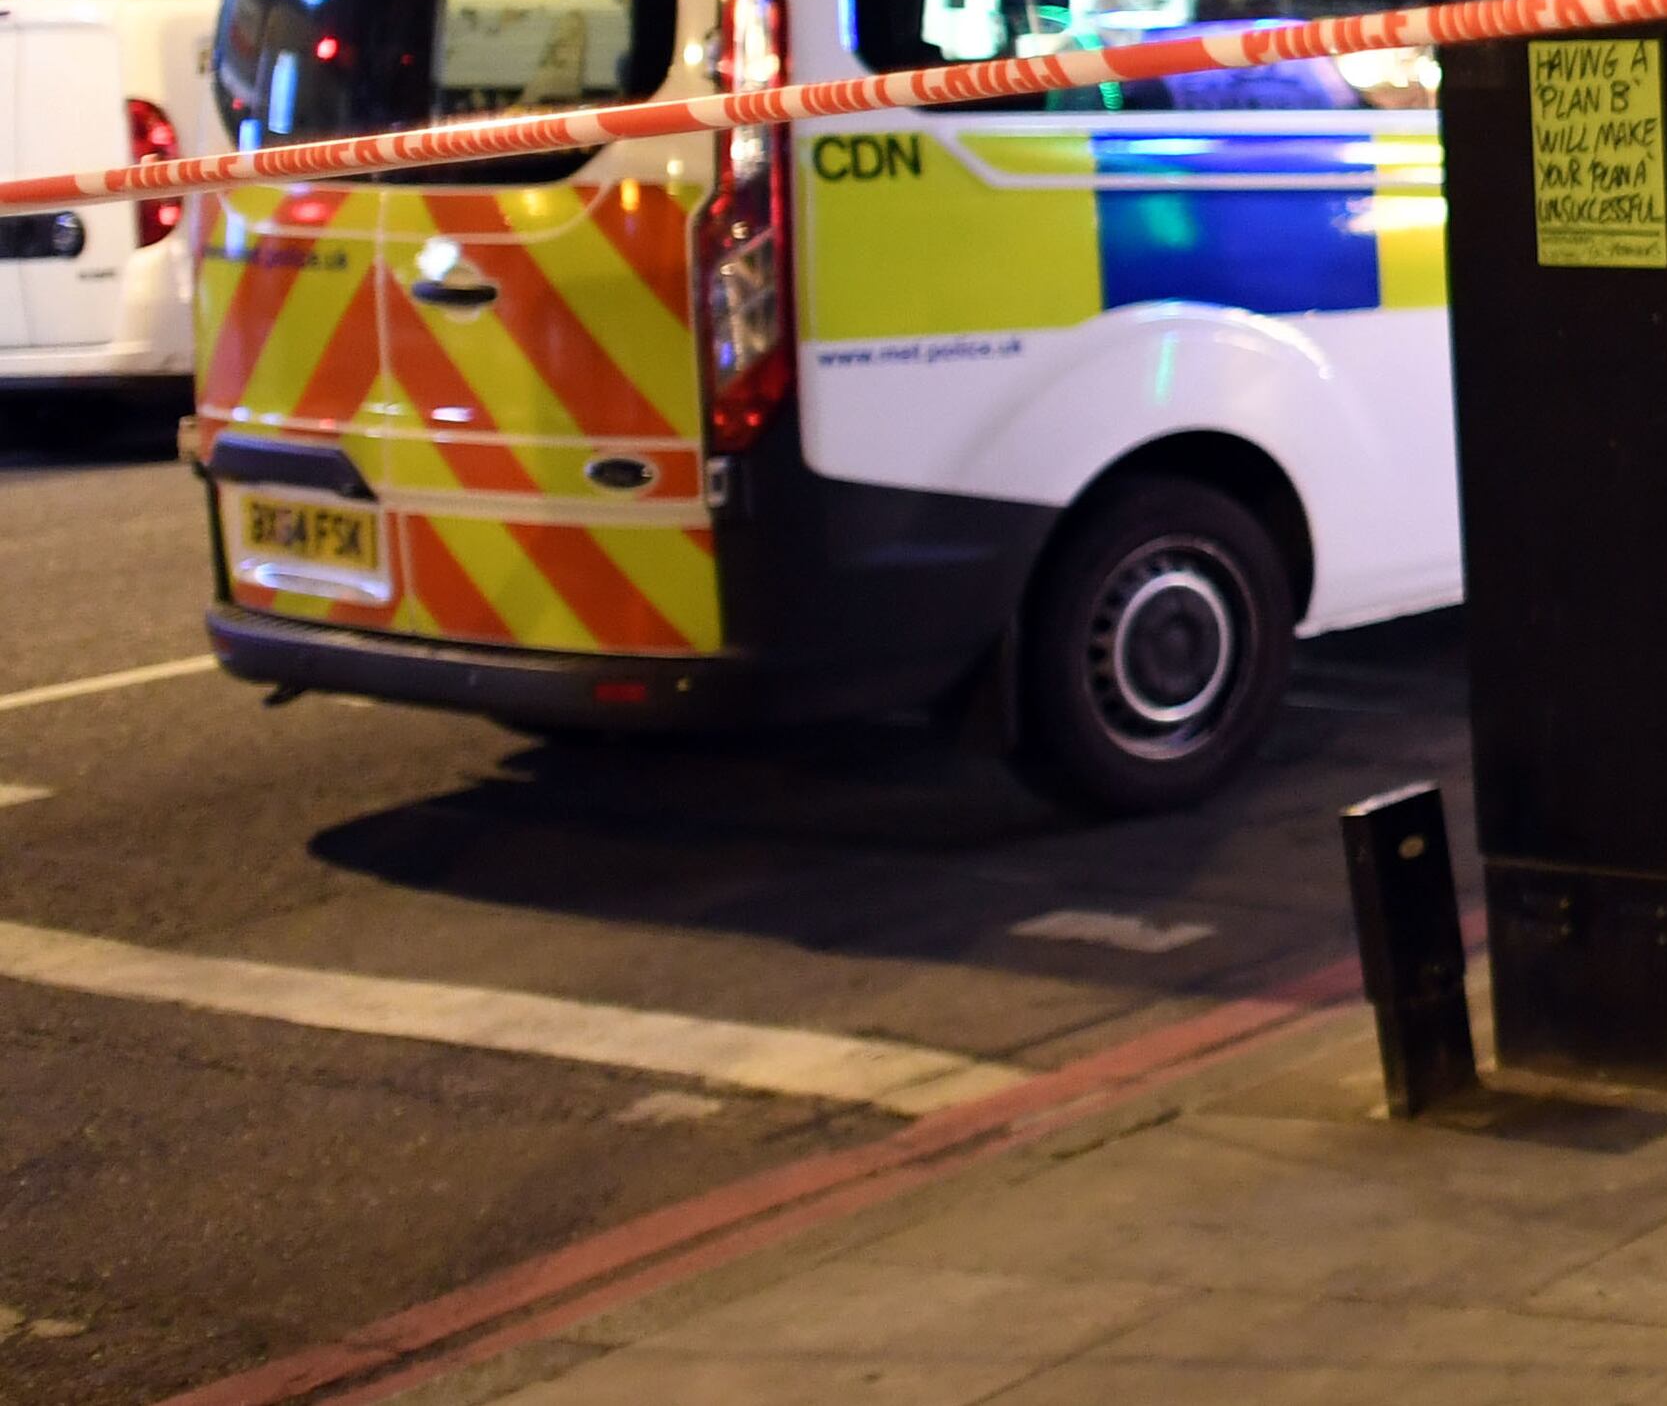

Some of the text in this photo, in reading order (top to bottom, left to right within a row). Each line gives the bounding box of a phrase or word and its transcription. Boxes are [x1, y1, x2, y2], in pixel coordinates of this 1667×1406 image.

[1536, 40, 1649, 82] HAVING A
[1536, 117, 1658, 155] WILL MAKE
[813, 134, 922, 182] CDN
[1538, 157, 1582, 192] YOUR
[1538, 192, 1663, 226] UNSUCCESSFUL
